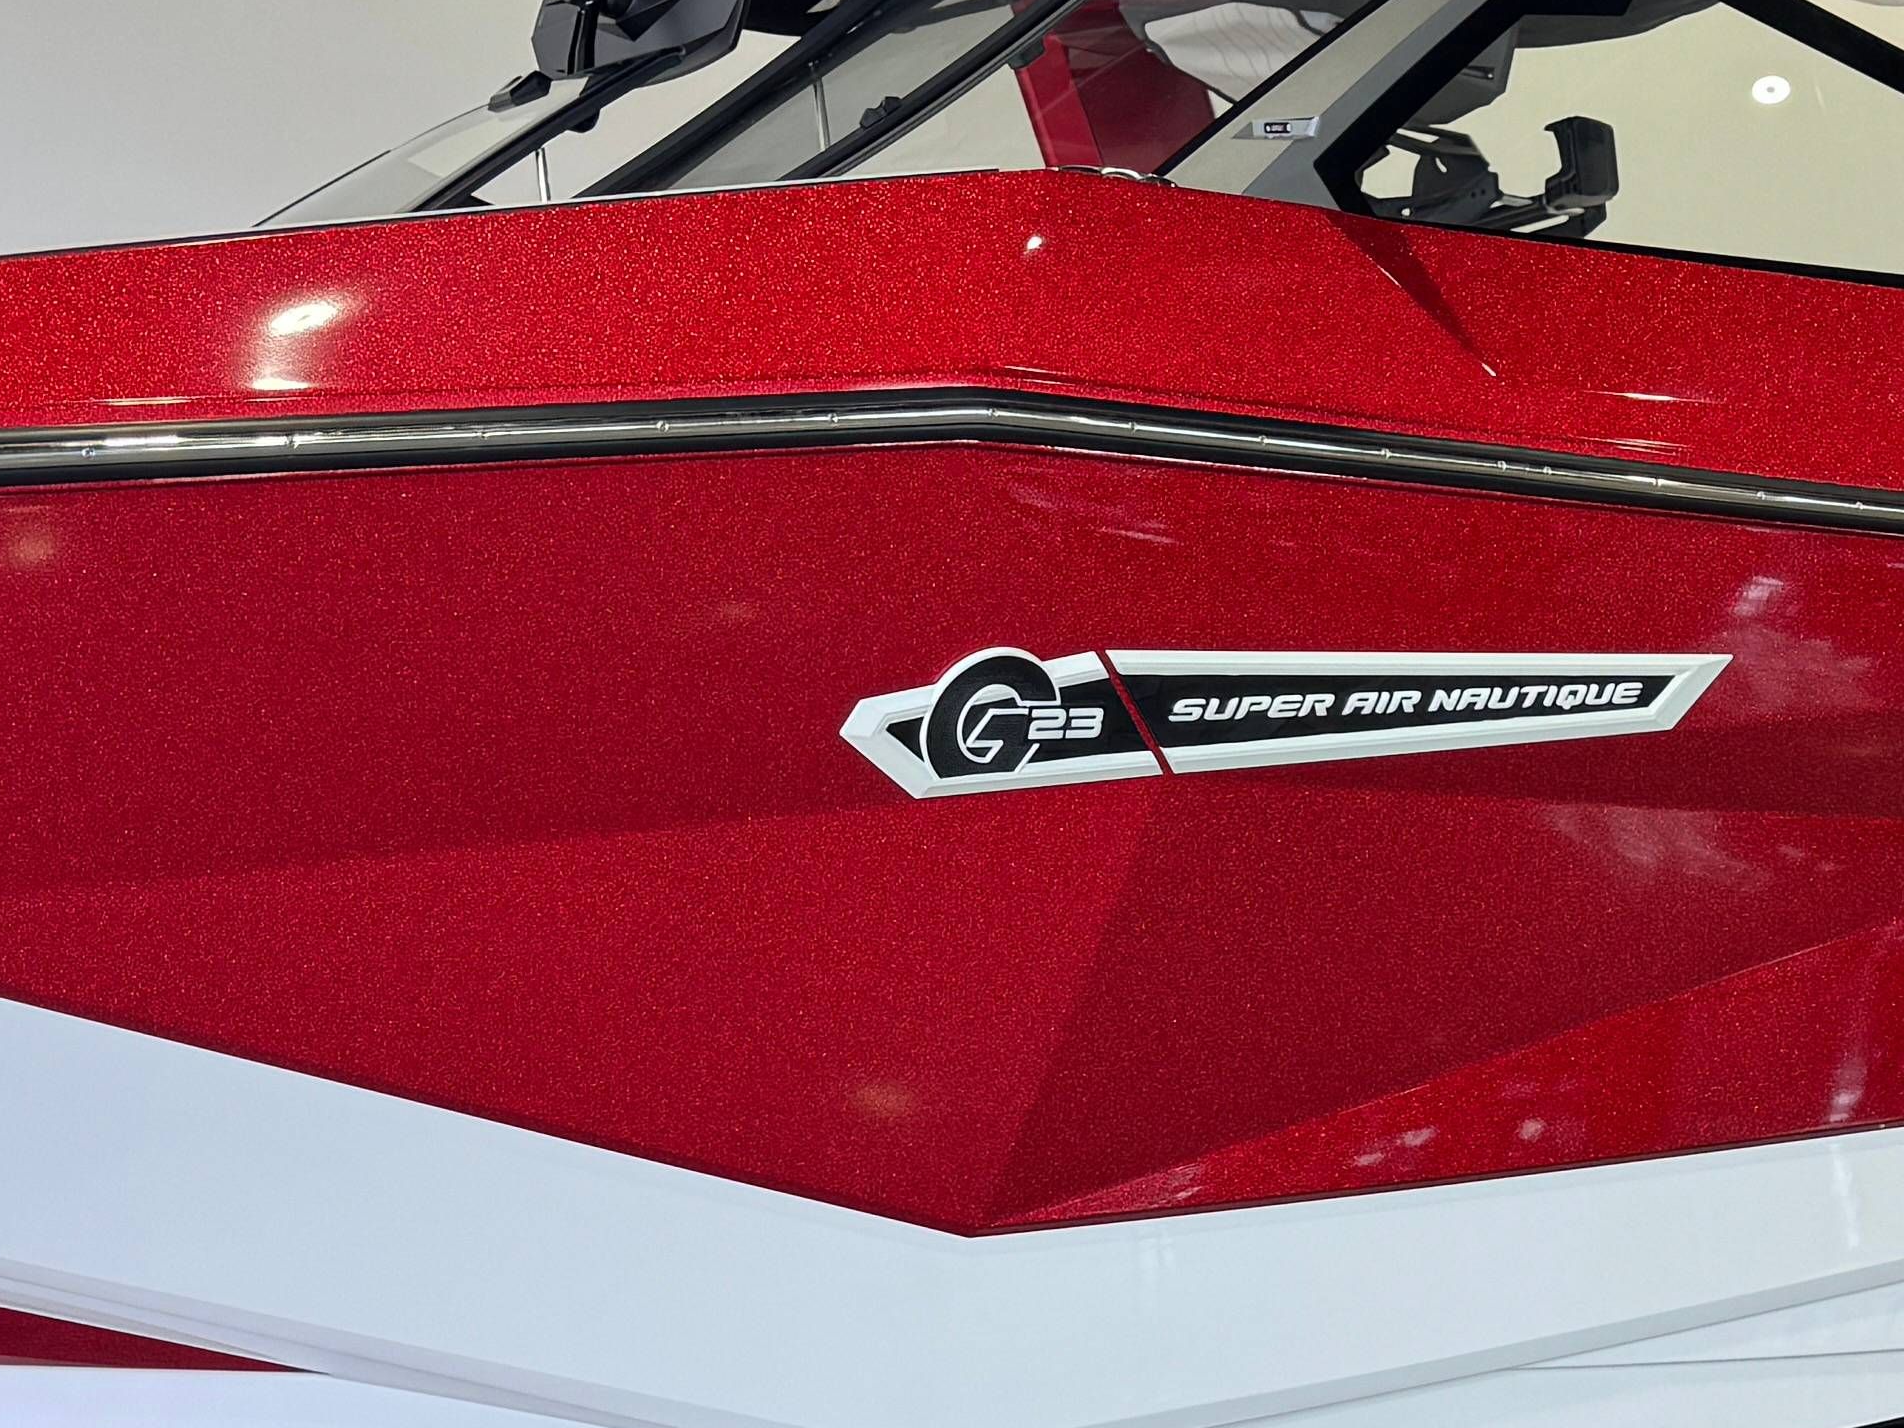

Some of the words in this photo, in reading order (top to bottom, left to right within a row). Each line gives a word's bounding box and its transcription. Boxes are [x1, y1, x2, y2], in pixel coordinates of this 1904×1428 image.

[1168, 693, 1335, 722] SUPER
[1341, 690, 1422, 716] AIR
[1428, 682, 1642, 711] NAUTIQUE
